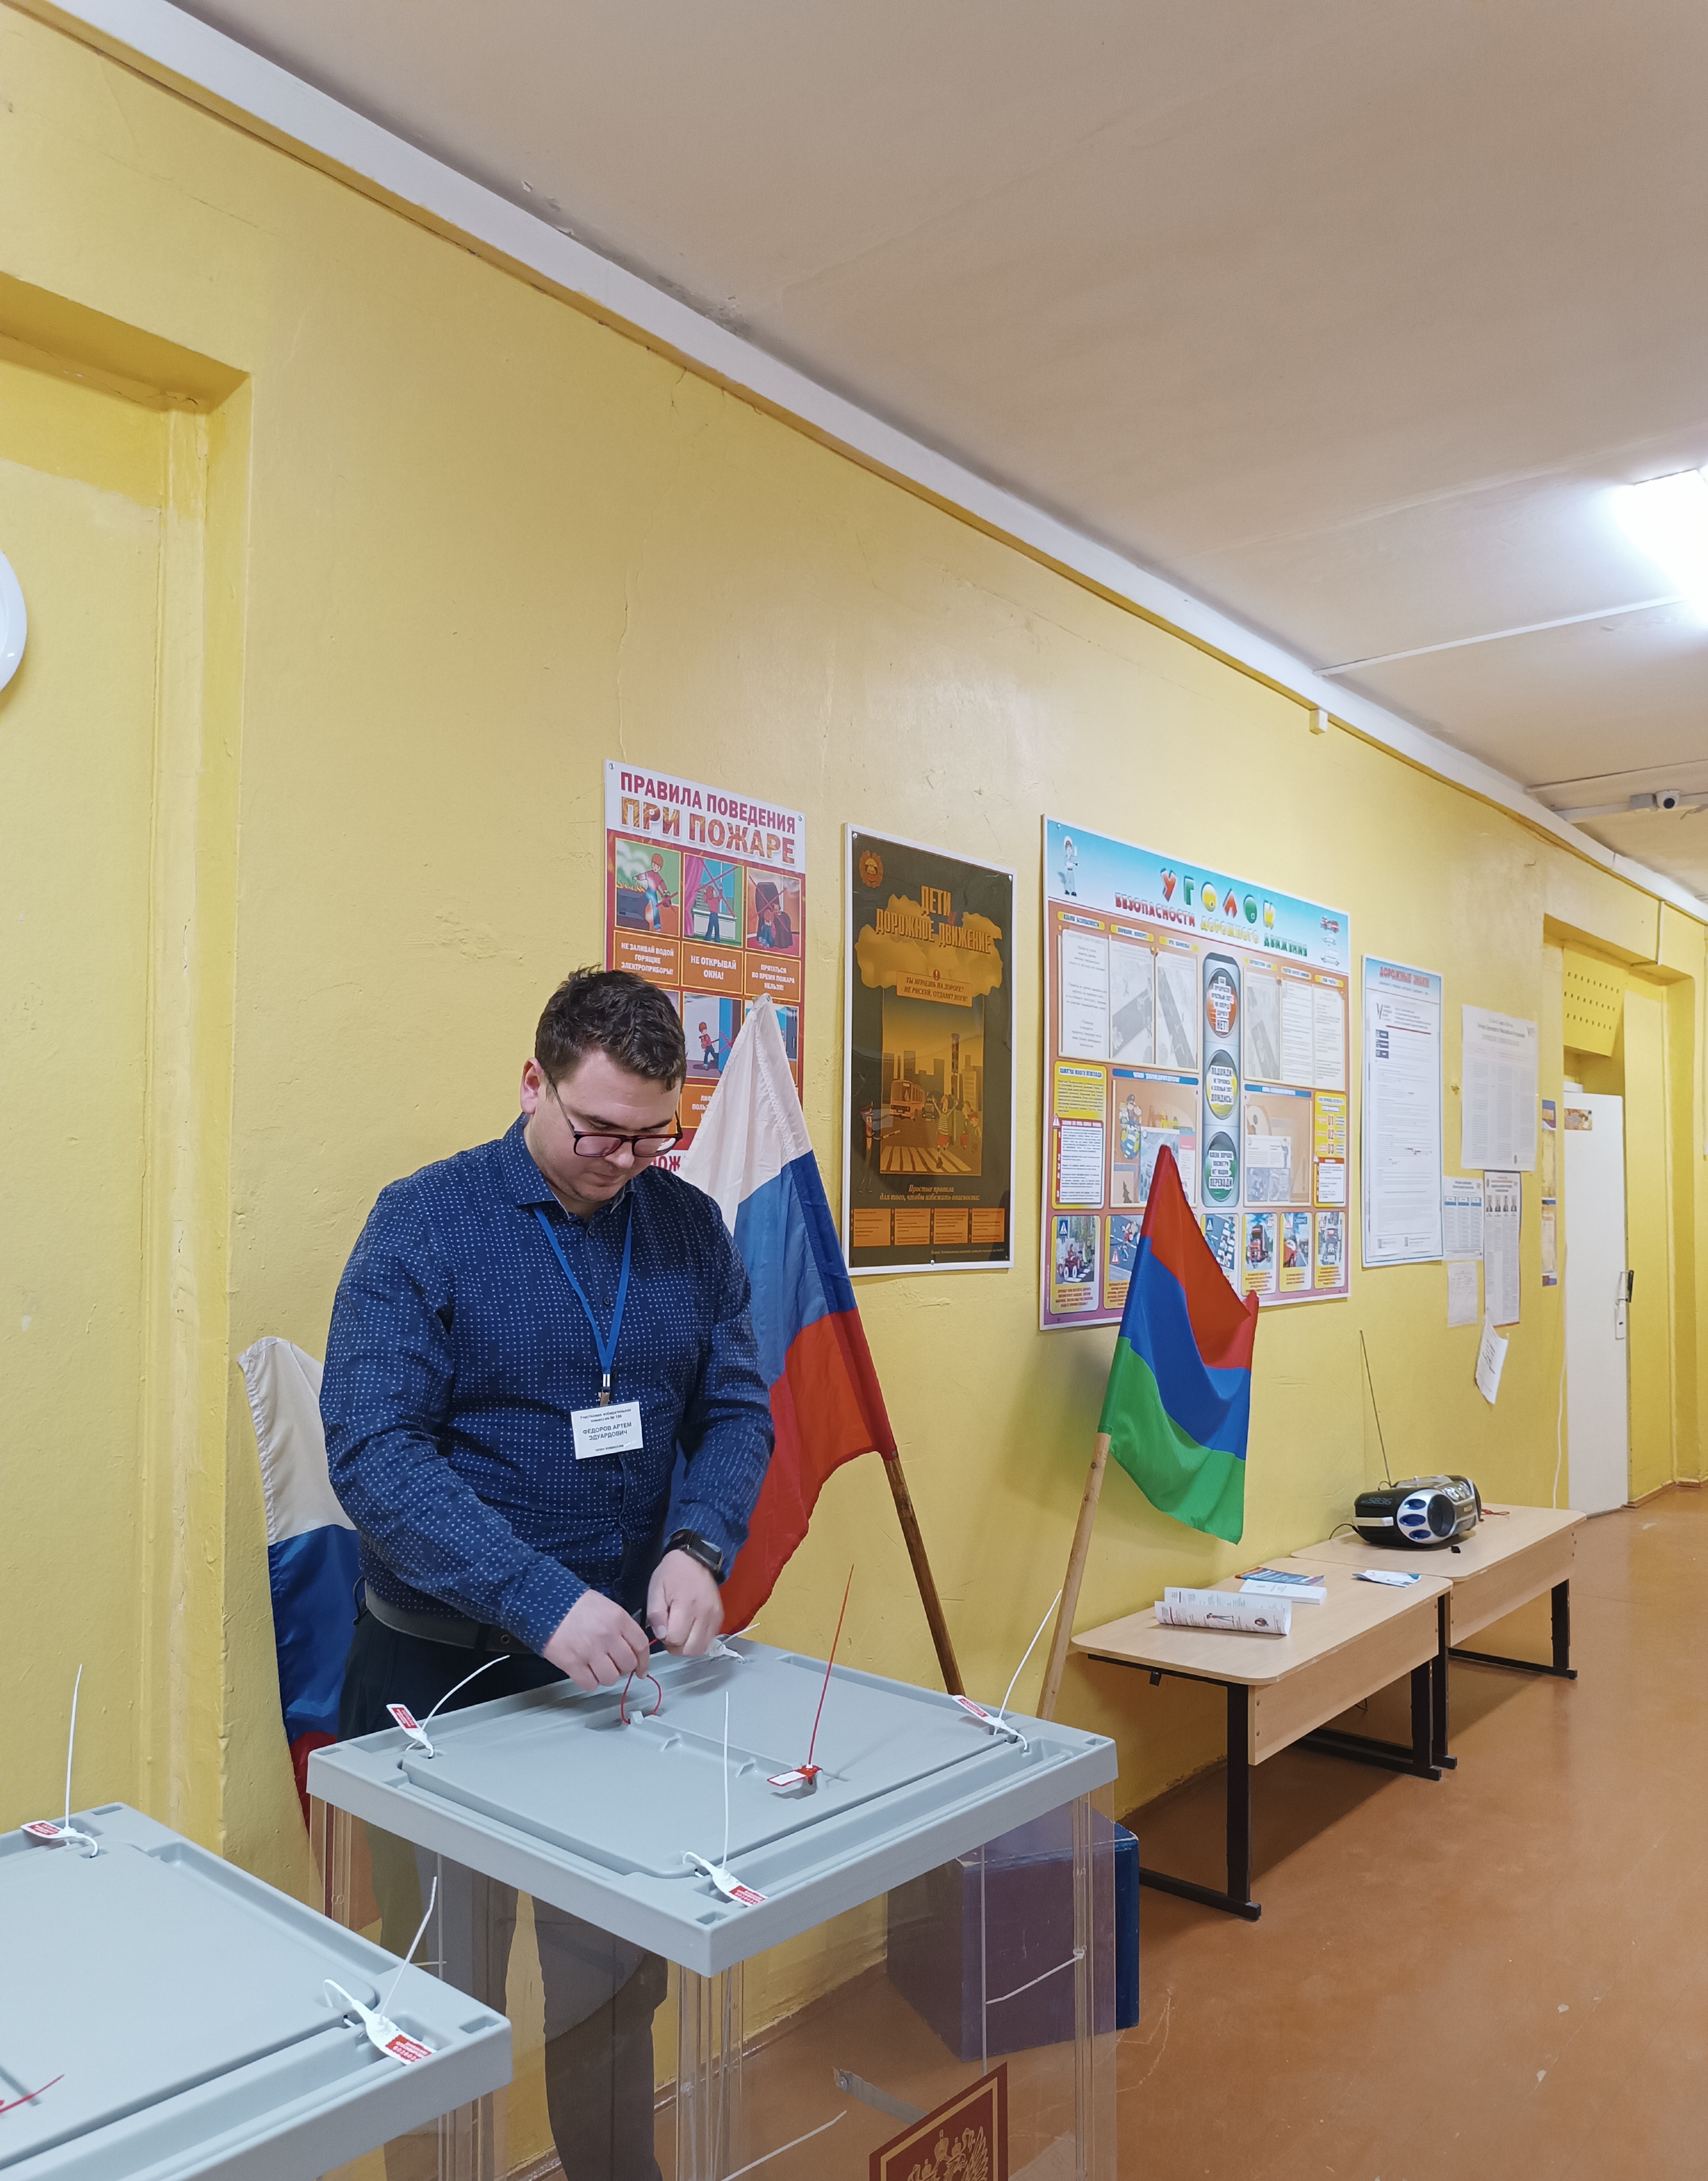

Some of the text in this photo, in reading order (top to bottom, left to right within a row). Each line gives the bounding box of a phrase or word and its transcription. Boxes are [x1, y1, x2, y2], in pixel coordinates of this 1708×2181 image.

[621, 772, 795, 834] ПРАВИЛА ПОВЕДЕНИЯ
[621, 796, 795, 864] ПРИ ПОЖАРЕ
[921, 885, 951, 916] ДЕТИ
[1115, 892, 1307, 957] БЕЗОПАСНОСТИ ДОРОЖНОГО ДВИЖЕНИЯ
[876, 909, 991, 954] ДОРОЖНОЕ ДВИЖЕНИЕ
[630, 943, 655, 954] ЗАЛИВАЙ
[656, 946, 674, 957] ВОДОЙ
[635, 954, 661, 964] ГОРЯЩИЕ
[691, 956, 737, 969] НЕ ОТКРЫВАЙ
[621, 961, 674, 975] ЭЛЕКТРОПРИБОРЫ!
[761, 964, 787, 974] ПРЯТАТЬСЯ
[704, 970, 724, 979] ОКНА!
[775, 975, 795, 983] ПОЖАРА
[1379, 966, 1411, 983] ДОРОЖНЫЕ
[764, 982, 784, 991] НЕЛЬЗЯ!
[915, 978, 936, 987] ИГРАЕШЬ
[944, 983, 964, 991] ДОРОГЕ?
[912, 987, 931, 997] РИСКУЙ,
[1328, 1129, 1334, 1139] 02
[1328, 1143, 1334, 1155] 03
[582, 1425, 611, 1434] ФЕДОРОВ
[589, 1429, 627, 1441] ЭДУАРДОВИЧ
